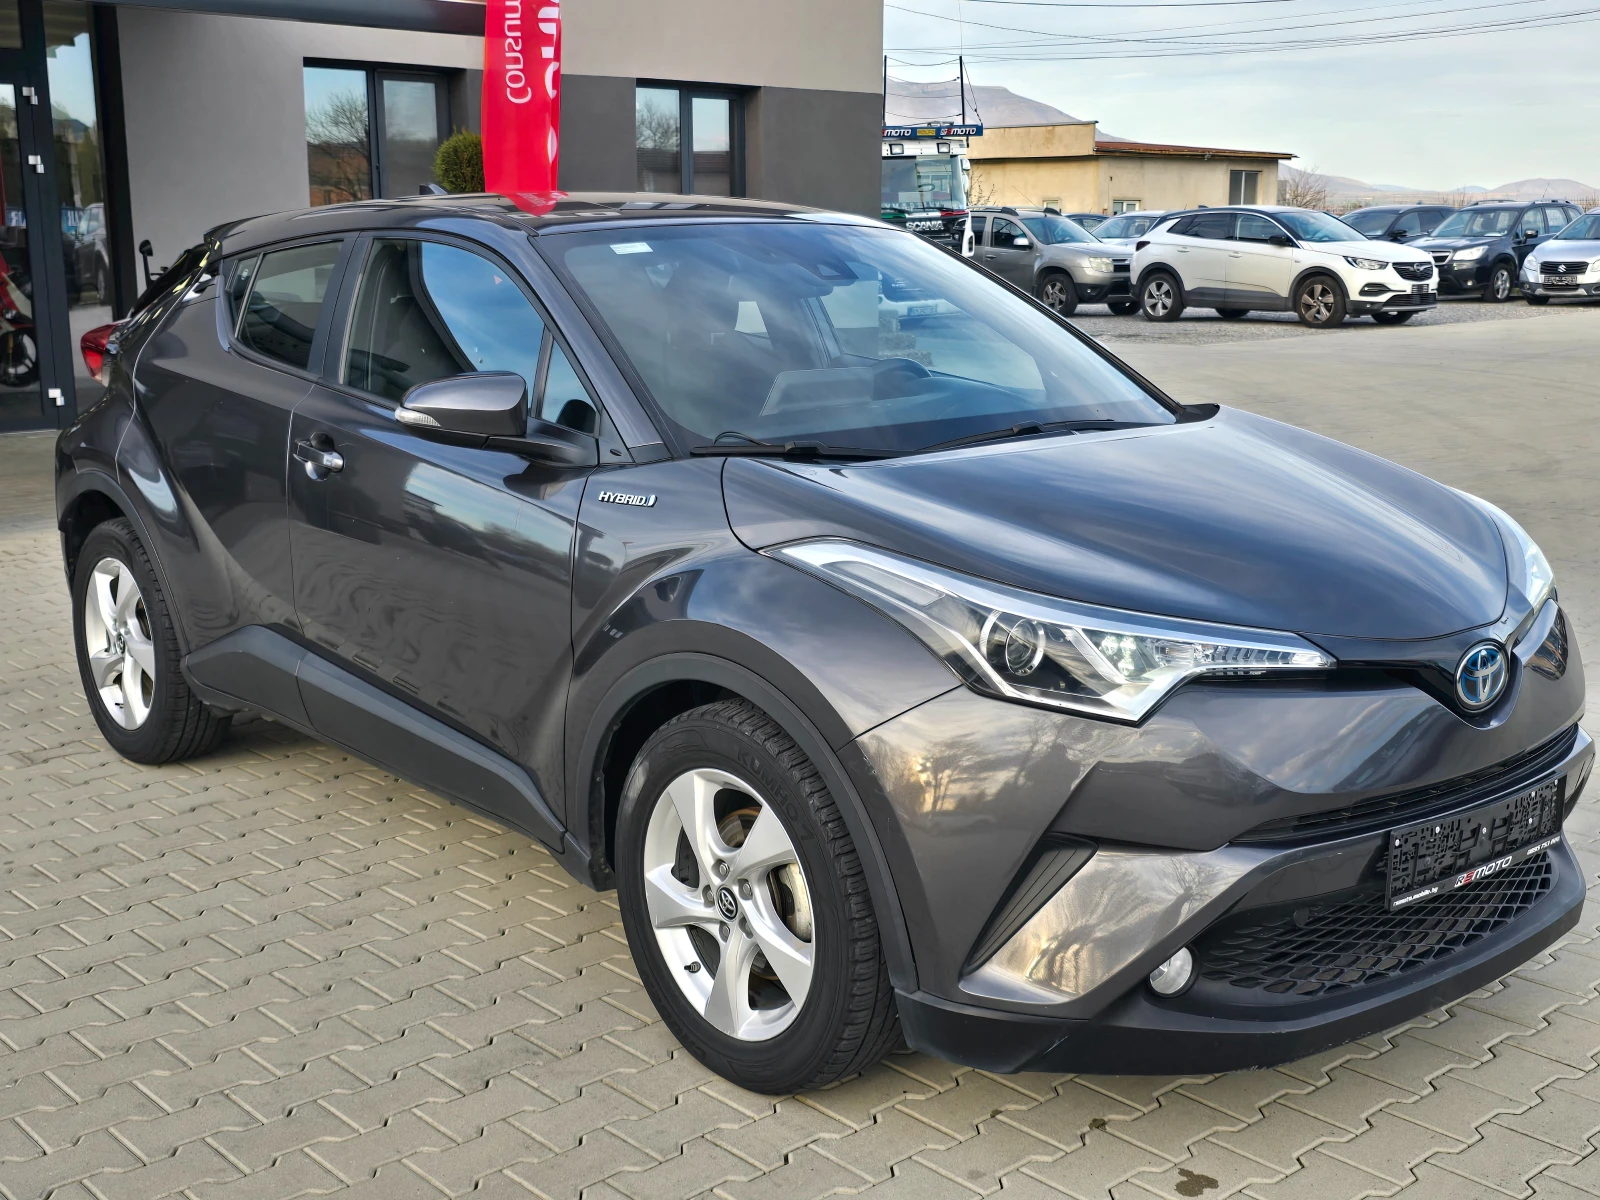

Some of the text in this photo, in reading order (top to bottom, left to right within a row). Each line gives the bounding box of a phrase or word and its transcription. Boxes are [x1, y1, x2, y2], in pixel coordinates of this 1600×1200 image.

[906, 221, 944, 231] SCANIA
[598, 491, 646, 506] HYBRID
[736, 748, 799, 822] KUMHO
[1454, 856, 1512, 888] RSMOTO
